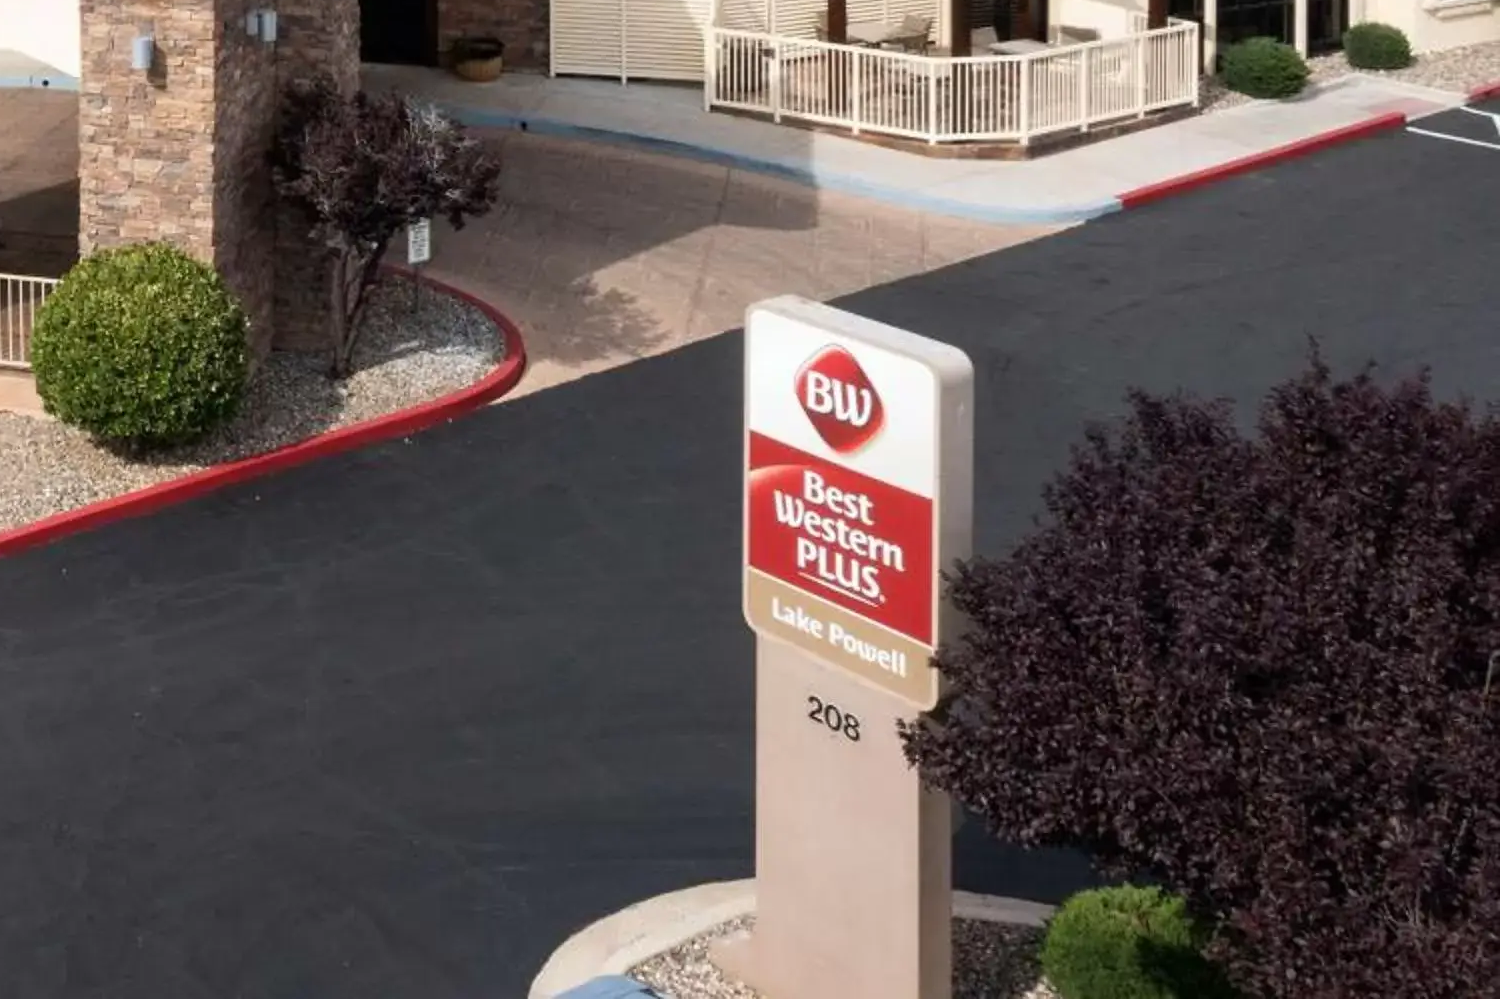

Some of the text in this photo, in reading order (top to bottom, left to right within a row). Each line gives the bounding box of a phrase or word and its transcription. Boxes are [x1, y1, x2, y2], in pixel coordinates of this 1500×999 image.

[805, 369, 873, 428] BW
[803, 469, 874, 526] Best
[773, 489, 905, 572] Western
[771, 596, 906, 678] Lake Powell
[807, 695, 861, 742] 208
